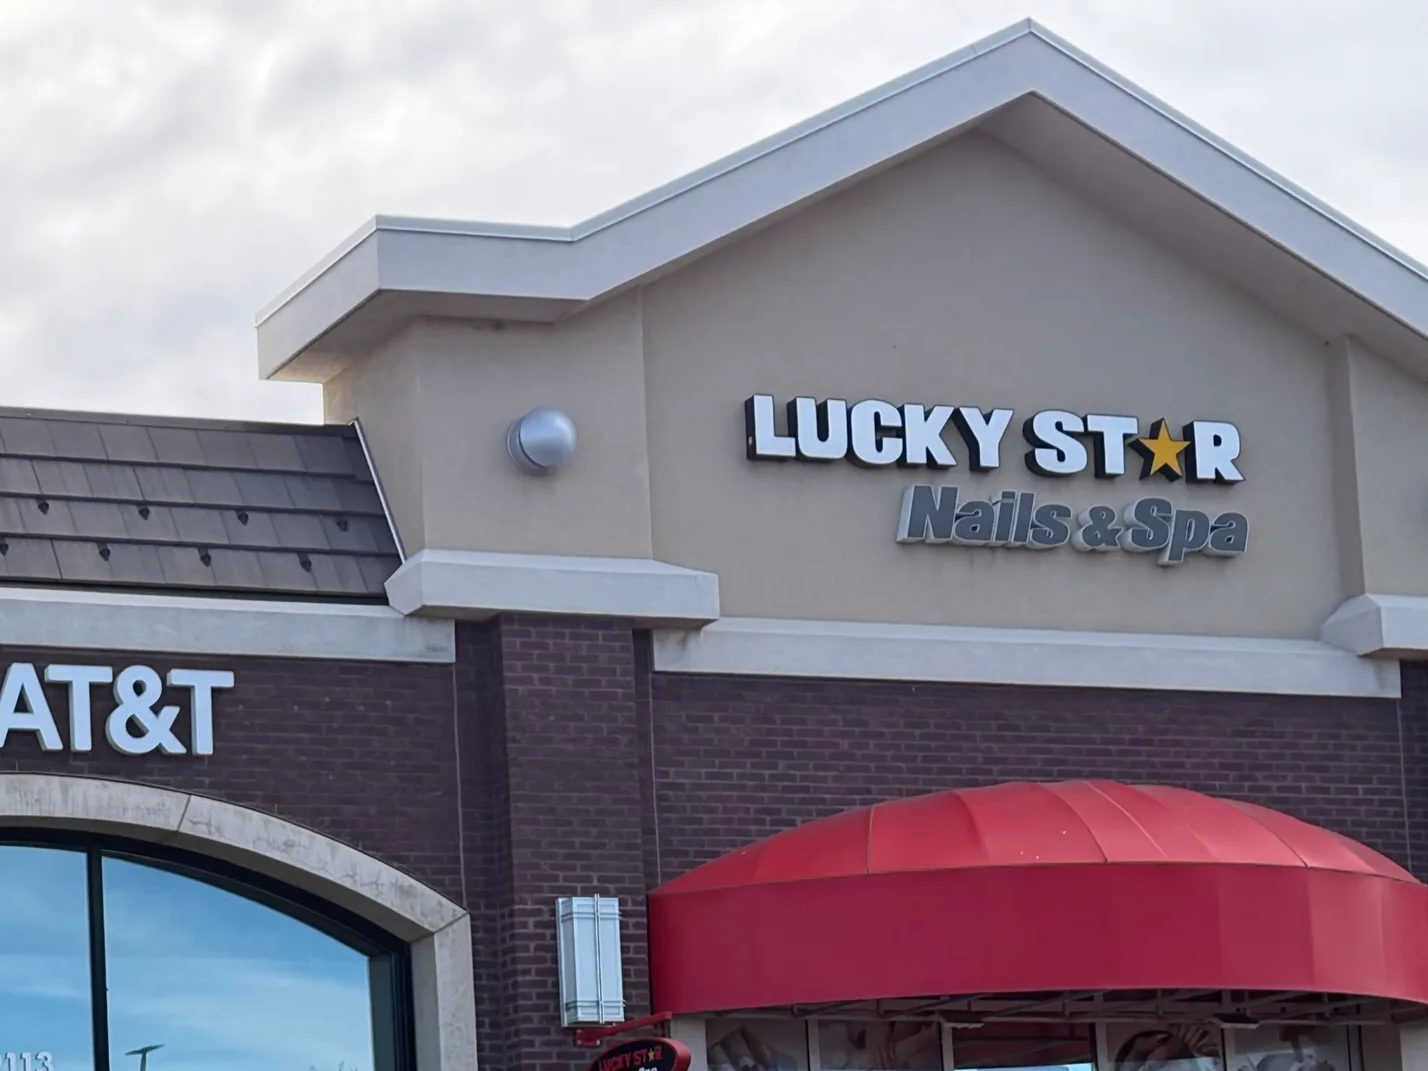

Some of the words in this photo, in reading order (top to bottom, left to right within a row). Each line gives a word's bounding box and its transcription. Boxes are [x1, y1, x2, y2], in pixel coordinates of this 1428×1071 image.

[745, 393, 1015, 473] LUCKY
[896, 484, 1072, 550] Nails
[1075, 505, 1124, 551] &
[1119, 497, 1250, 565] Spa
